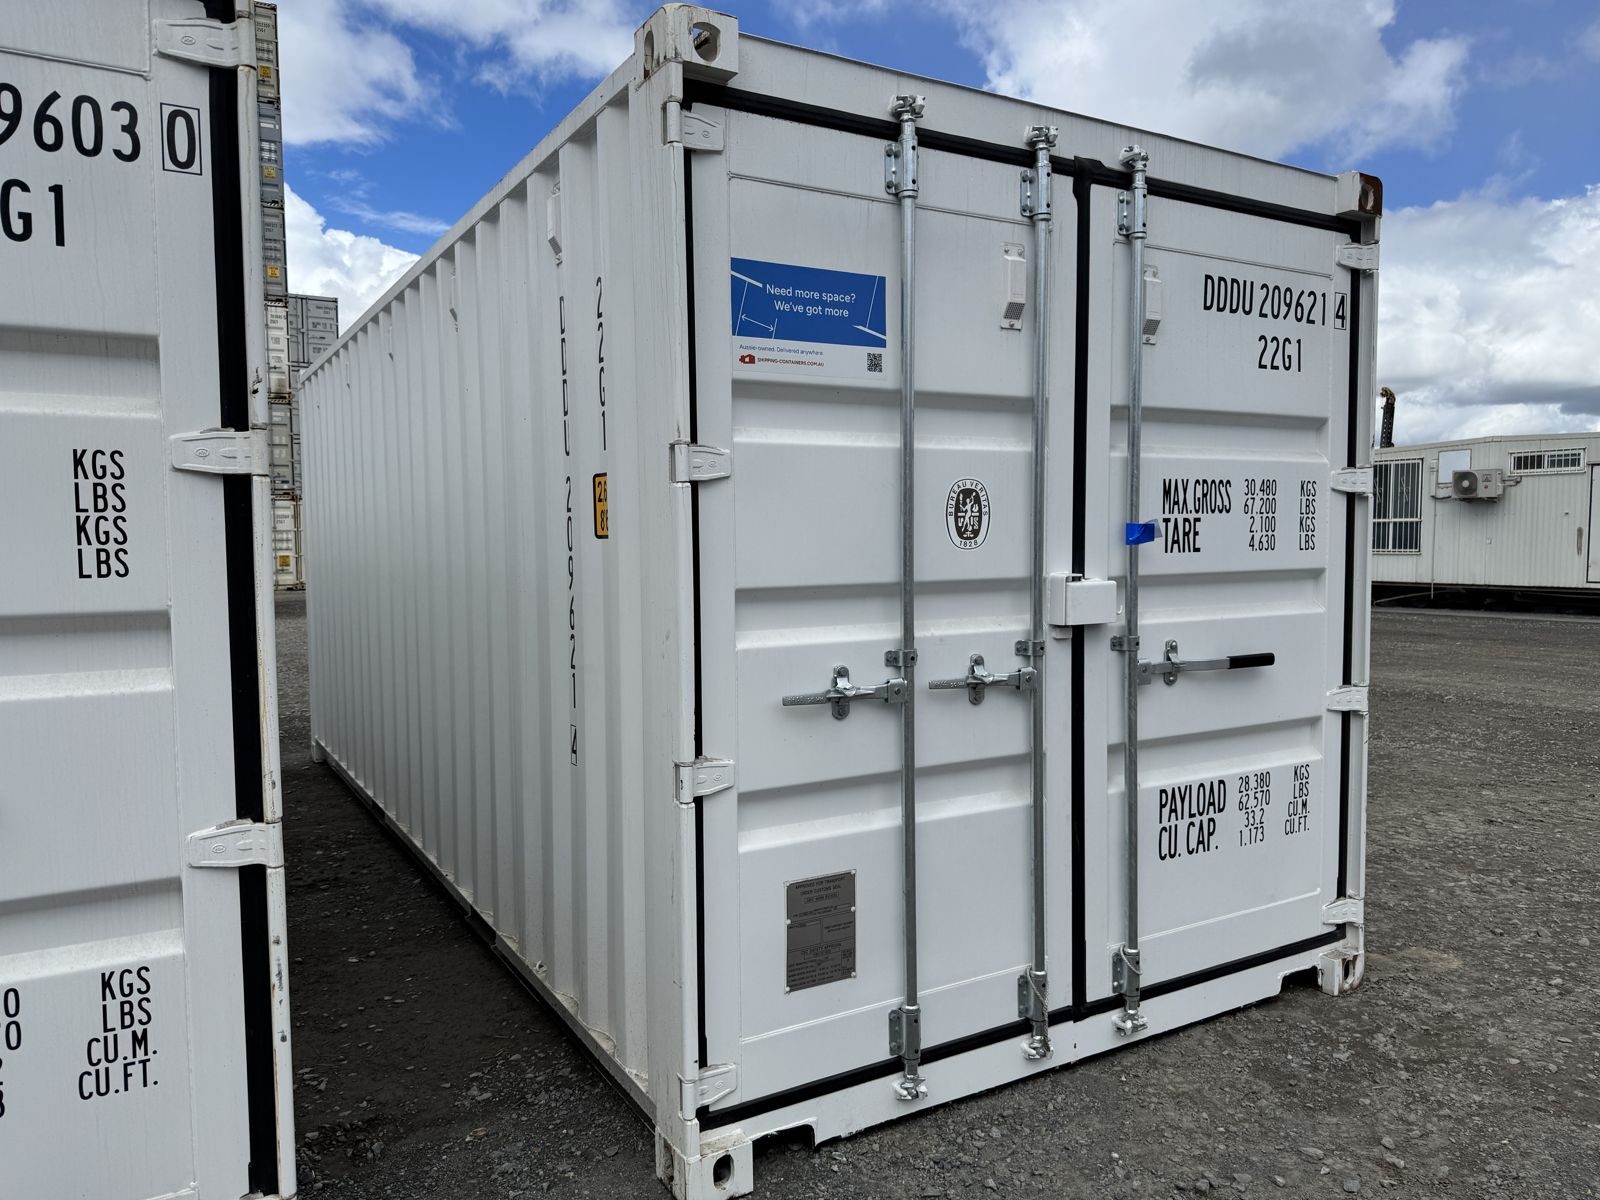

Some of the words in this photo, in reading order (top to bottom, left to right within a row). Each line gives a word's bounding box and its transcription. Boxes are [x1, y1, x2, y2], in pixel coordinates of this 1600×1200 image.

[165, 108, 198, 171] 0
[0, 178, 66, 247] G1
[766, 283, 793, 297] Need
[795, 289, 820, 300] more
[822, 292, 856, 304] space?
[774, 300, 804, 313] We've
[806, 305, 823, 317] got
[825, 307, 849, 317] more
[1203, 274, 1254, 316] DDDU
[1258, 283, 1327, 326] 209621
[1335, 294, 1346, 329] 4
[596, 276, 606, 451] 22G1
[776, 346, 800, 354] Delivered
[1258, 335, 1302, 373] 22G1
[72, 449, 125, 480] KGS
[74, 482, 127, 513] LBS
[948, 481, 967, 517] BUREAU
[970, 481, 988, 517] VERITAS
[1162, 478, 1232, 515] MAX.GROSS
[1243, 479, 1277, 497] 30.480
[1300, 481, 1317, 498] KGS
[1243, 497, 1277, 515] 67.200
[1299, 498, 1316, 515] LBS
[76, 515, 128, 546] KGS
[1162, 517, 1202, 554] TARE
[1249, 516, 1276, 533] 2.100
[1299, 516, 1316, 533] KGS
[1249, 534, 1276, 551] 4.630
[1299, 534, 1316, 551] LBS
[77, 548, 130, 579] LBS
[1159, 779, 1227, 825] PAYLOAD
[1238, 771, 1271, 794] 28.380
[1293, 764, 1310, 782] KGS
[1238, 789, 1271, 811] 62.570
[1293, 781, 1310, 799] LBS
[1158, 824, 1182, 861] CU.
[1186, 817, 1219, 855] CAP.
[1244, 808, 1265, 828] 33.2
[1287, 798, 1310, 818] CU.M.
[1239, 826, 1265, 847] 1.173
[1284, 815, 1310, 836] CU.FT.
[101, 965, 151, 1002] KGS
[102, 997, 152, 1033] LBS
[87, 1028, 158, 1067] CU.M.
[78, 1058, 159, 1100] CU.FT.
